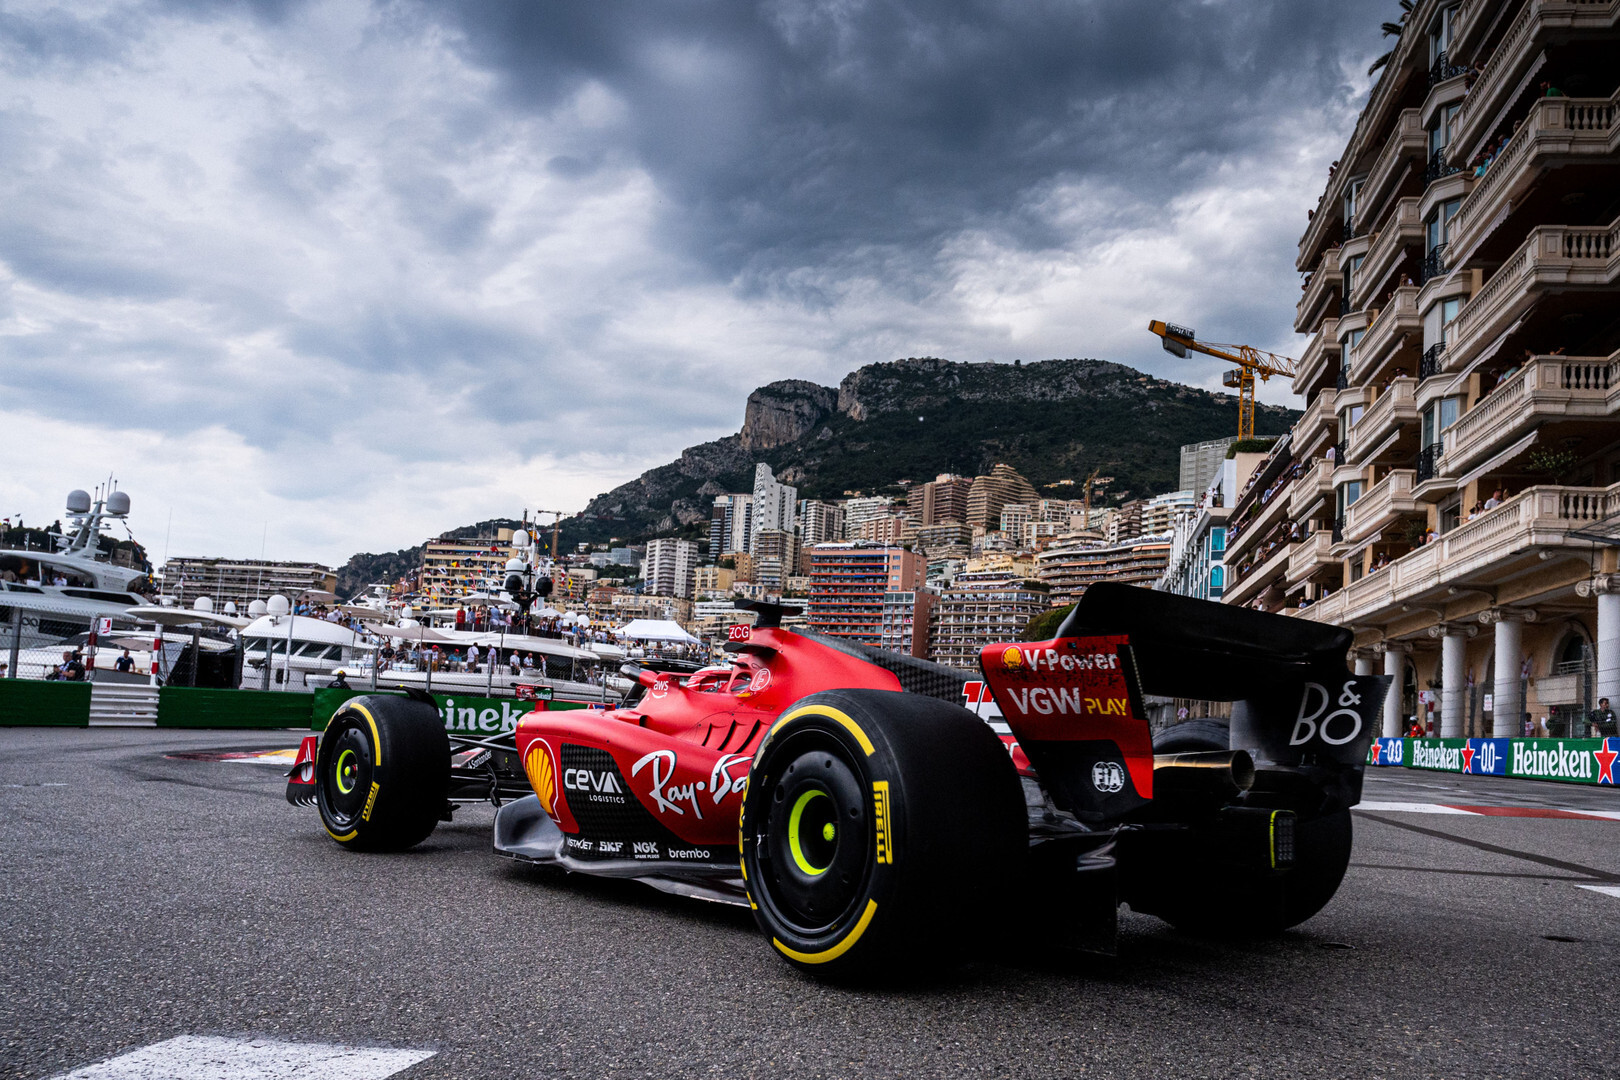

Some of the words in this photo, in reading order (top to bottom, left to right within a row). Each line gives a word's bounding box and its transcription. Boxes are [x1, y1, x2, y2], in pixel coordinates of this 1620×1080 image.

[729, 625, 749, 639] ZCG
[1024, 648, 1118, 672] V-Power
[653, 680, 669, 691] aws
[1006, 686, 1083, 716] VGW
[1084, 697, 1128, 718] PLAY
[438, 698, 524, 732] inek
[1412, 740, 1460, 770] Heineken
[1480, 742, 1495, 773] 0.0
[1512, 741, 1592, 779] Heineken
[1093, 766, 1121, 787] FIA
[589, 794, 626, 804] LOGISTICS
[872, 780, 894, 865] PIRELLI
[599, 840, 624, 852] SKF
[633, 841, 659, 854] NGK
[668, 848, 711, 859] brembo
